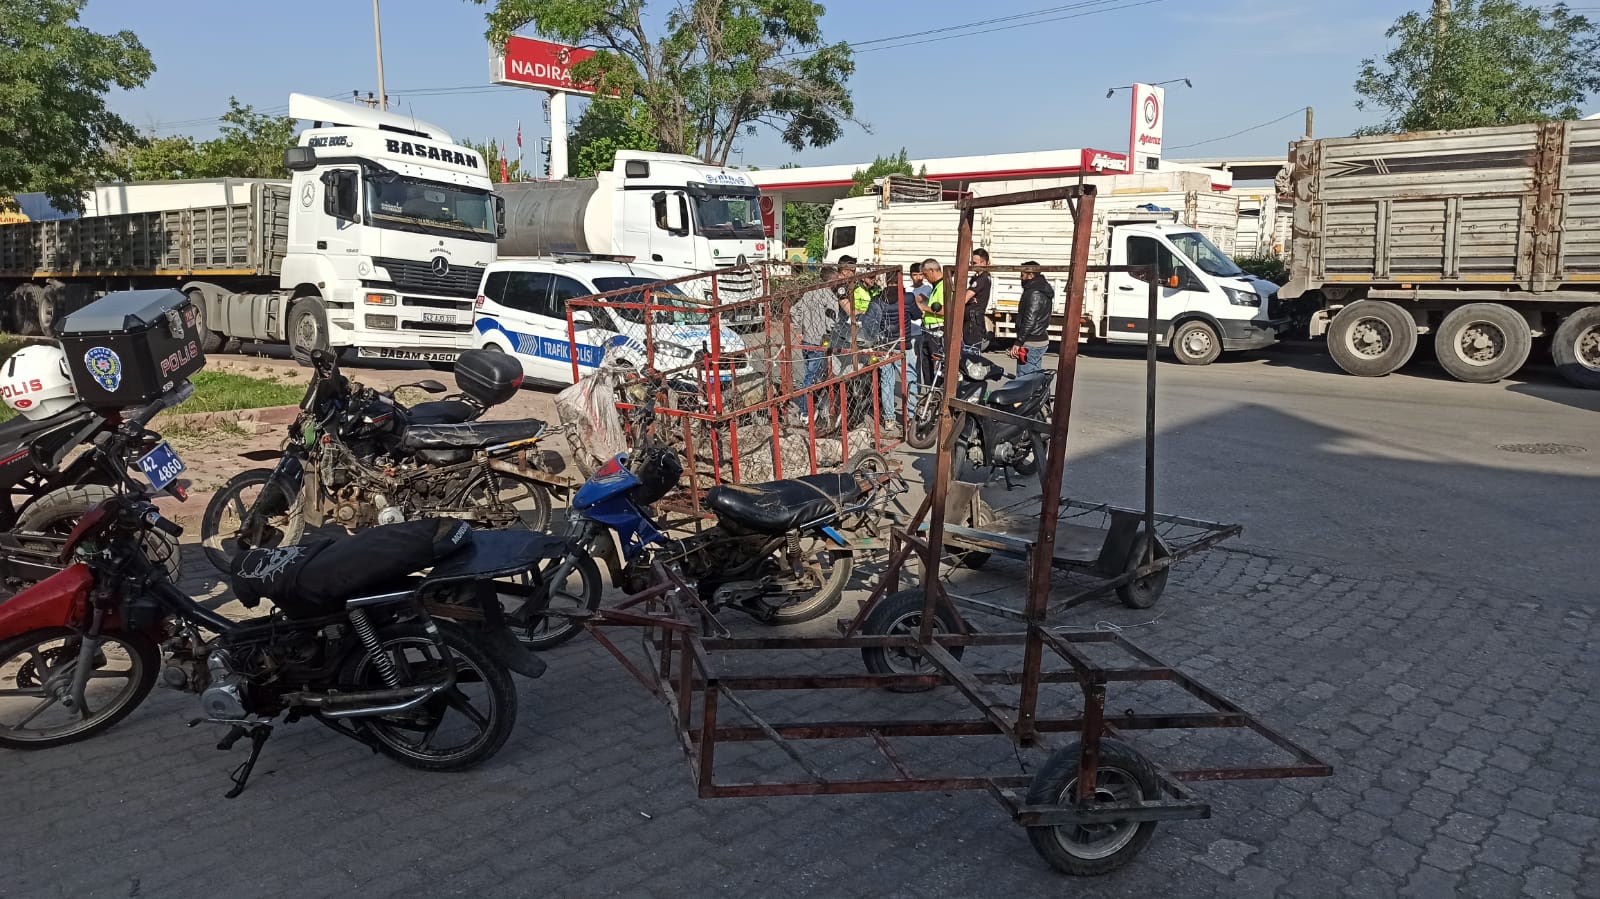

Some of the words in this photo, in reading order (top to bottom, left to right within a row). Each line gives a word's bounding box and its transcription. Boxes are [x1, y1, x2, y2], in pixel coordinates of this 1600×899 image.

[380, 347, 421, 360] BABAM
[569, 346, 594, 364] OLİSİ
[142, 456, 158, 473] 42
[158, 458, 182, 482] 4860
